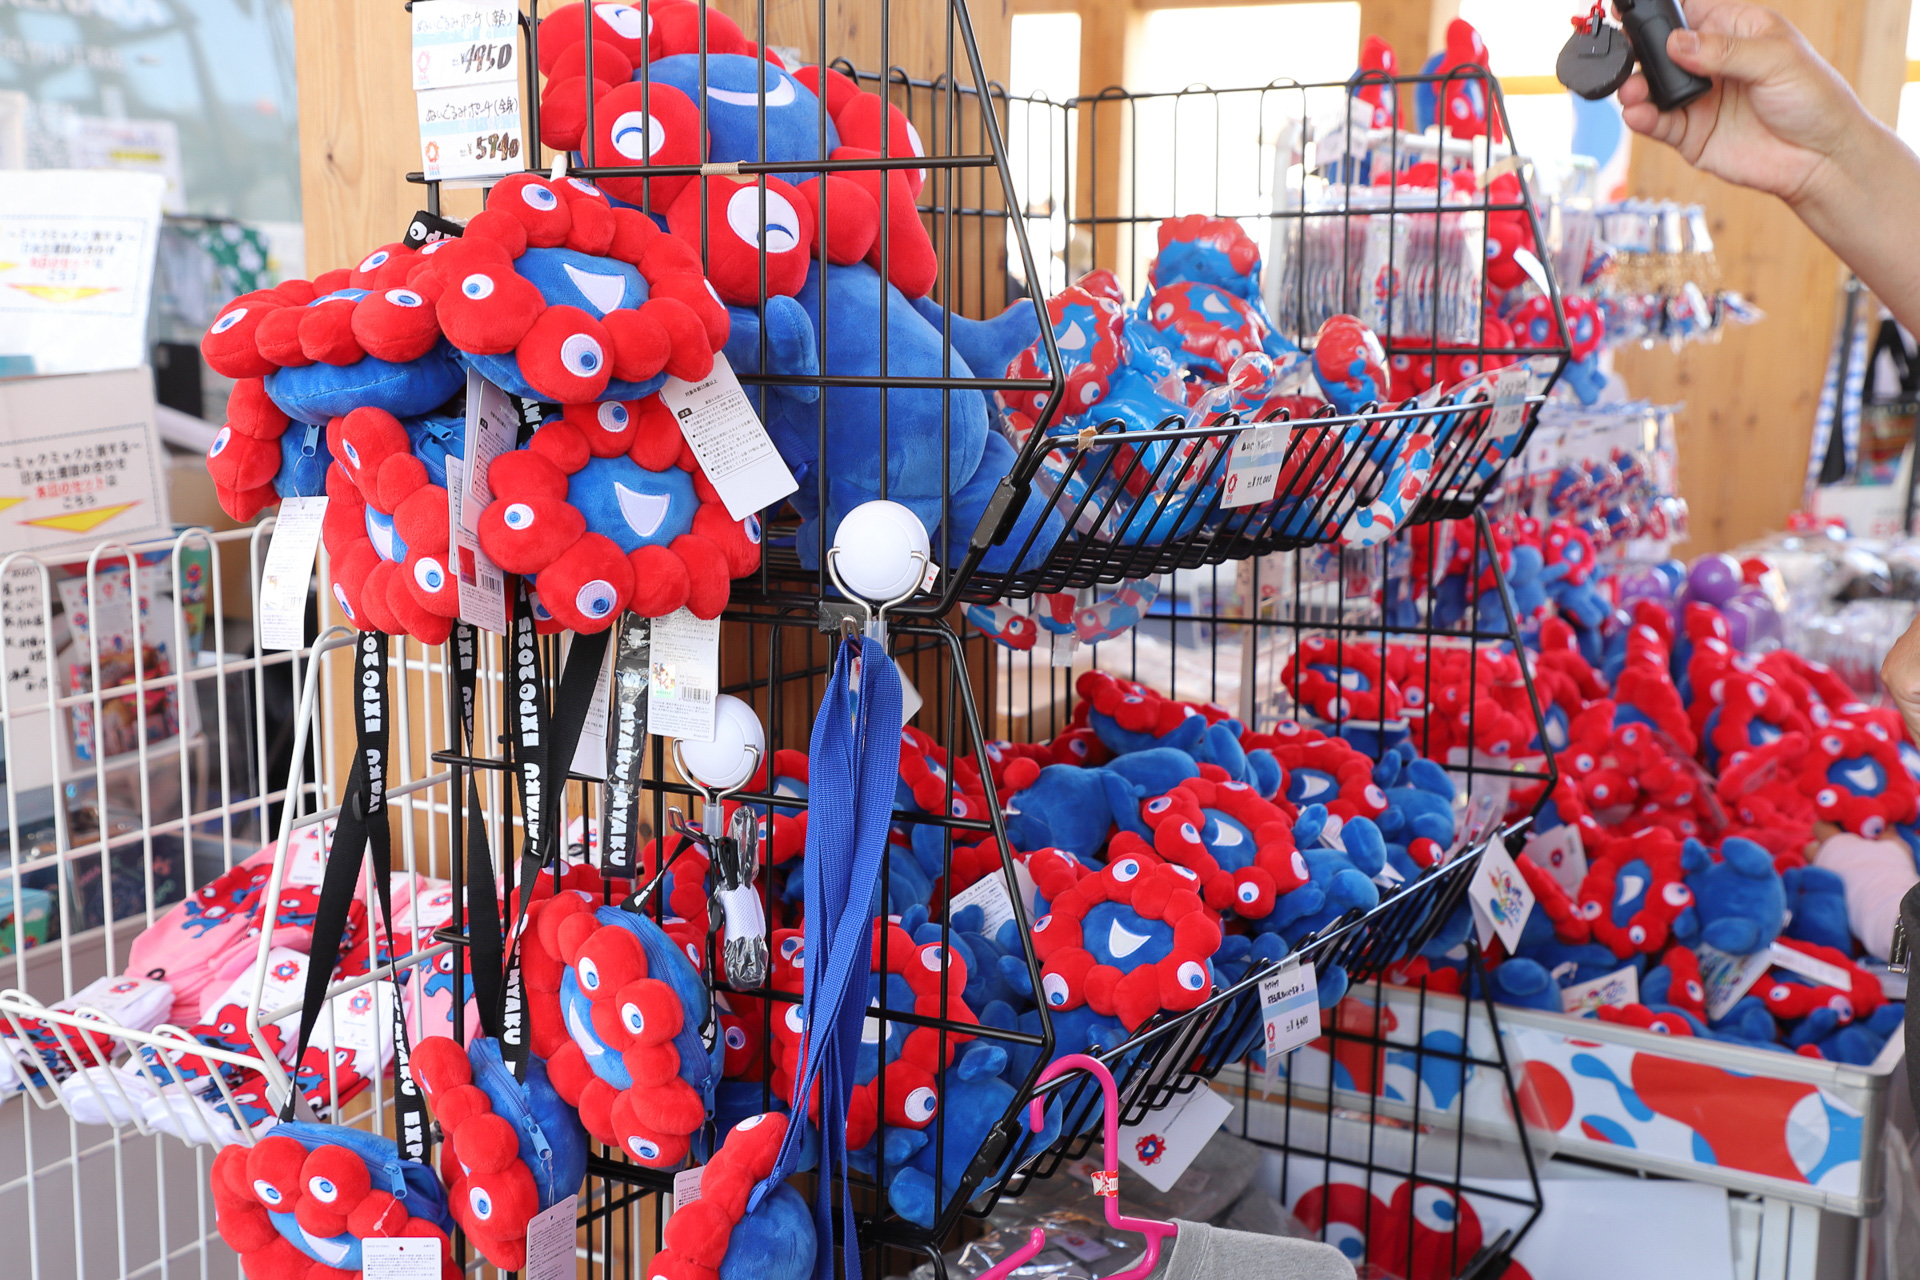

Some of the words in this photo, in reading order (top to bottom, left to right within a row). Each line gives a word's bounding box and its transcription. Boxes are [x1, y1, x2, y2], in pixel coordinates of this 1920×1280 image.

[518, 616, 536, 682] 2025
[362, 670, 381, 733] EXPO
[519, 683, 539, 747] EXPO
